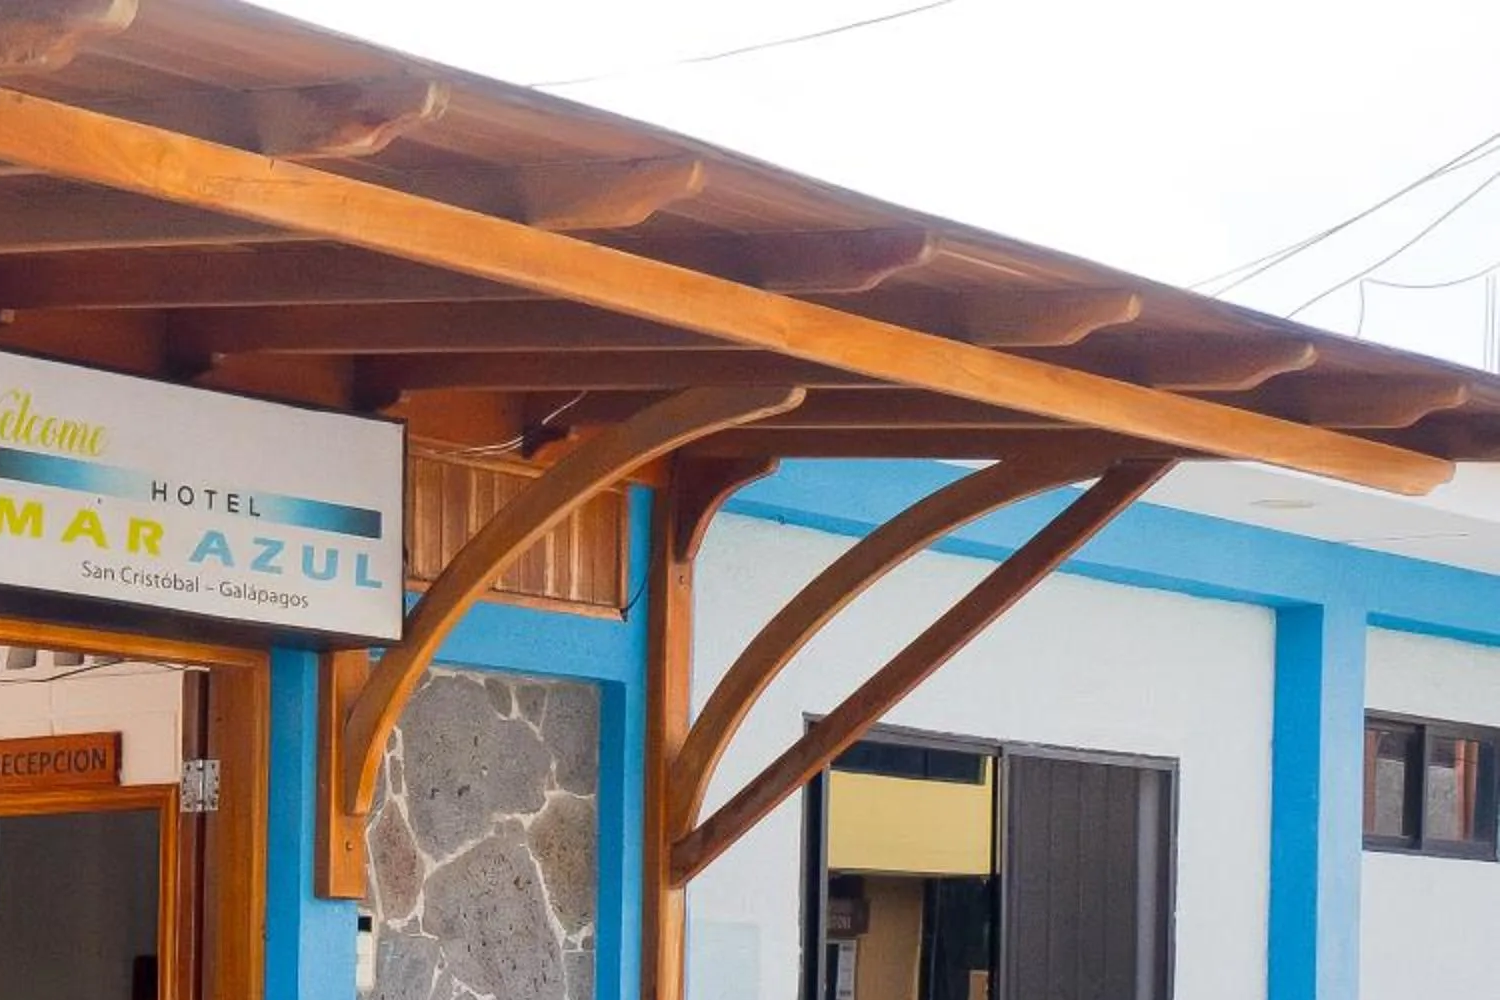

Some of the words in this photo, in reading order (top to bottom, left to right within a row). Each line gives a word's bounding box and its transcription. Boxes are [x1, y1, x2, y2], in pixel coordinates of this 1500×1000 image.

[152, 480, 260, 517] HOTEL
[189, 530, 382, 588] AZUL
[81, 560, 115, 581] San
[120, 566, 199, 592] Cristóbal
[219, 580, 309, 609] Galápagos
